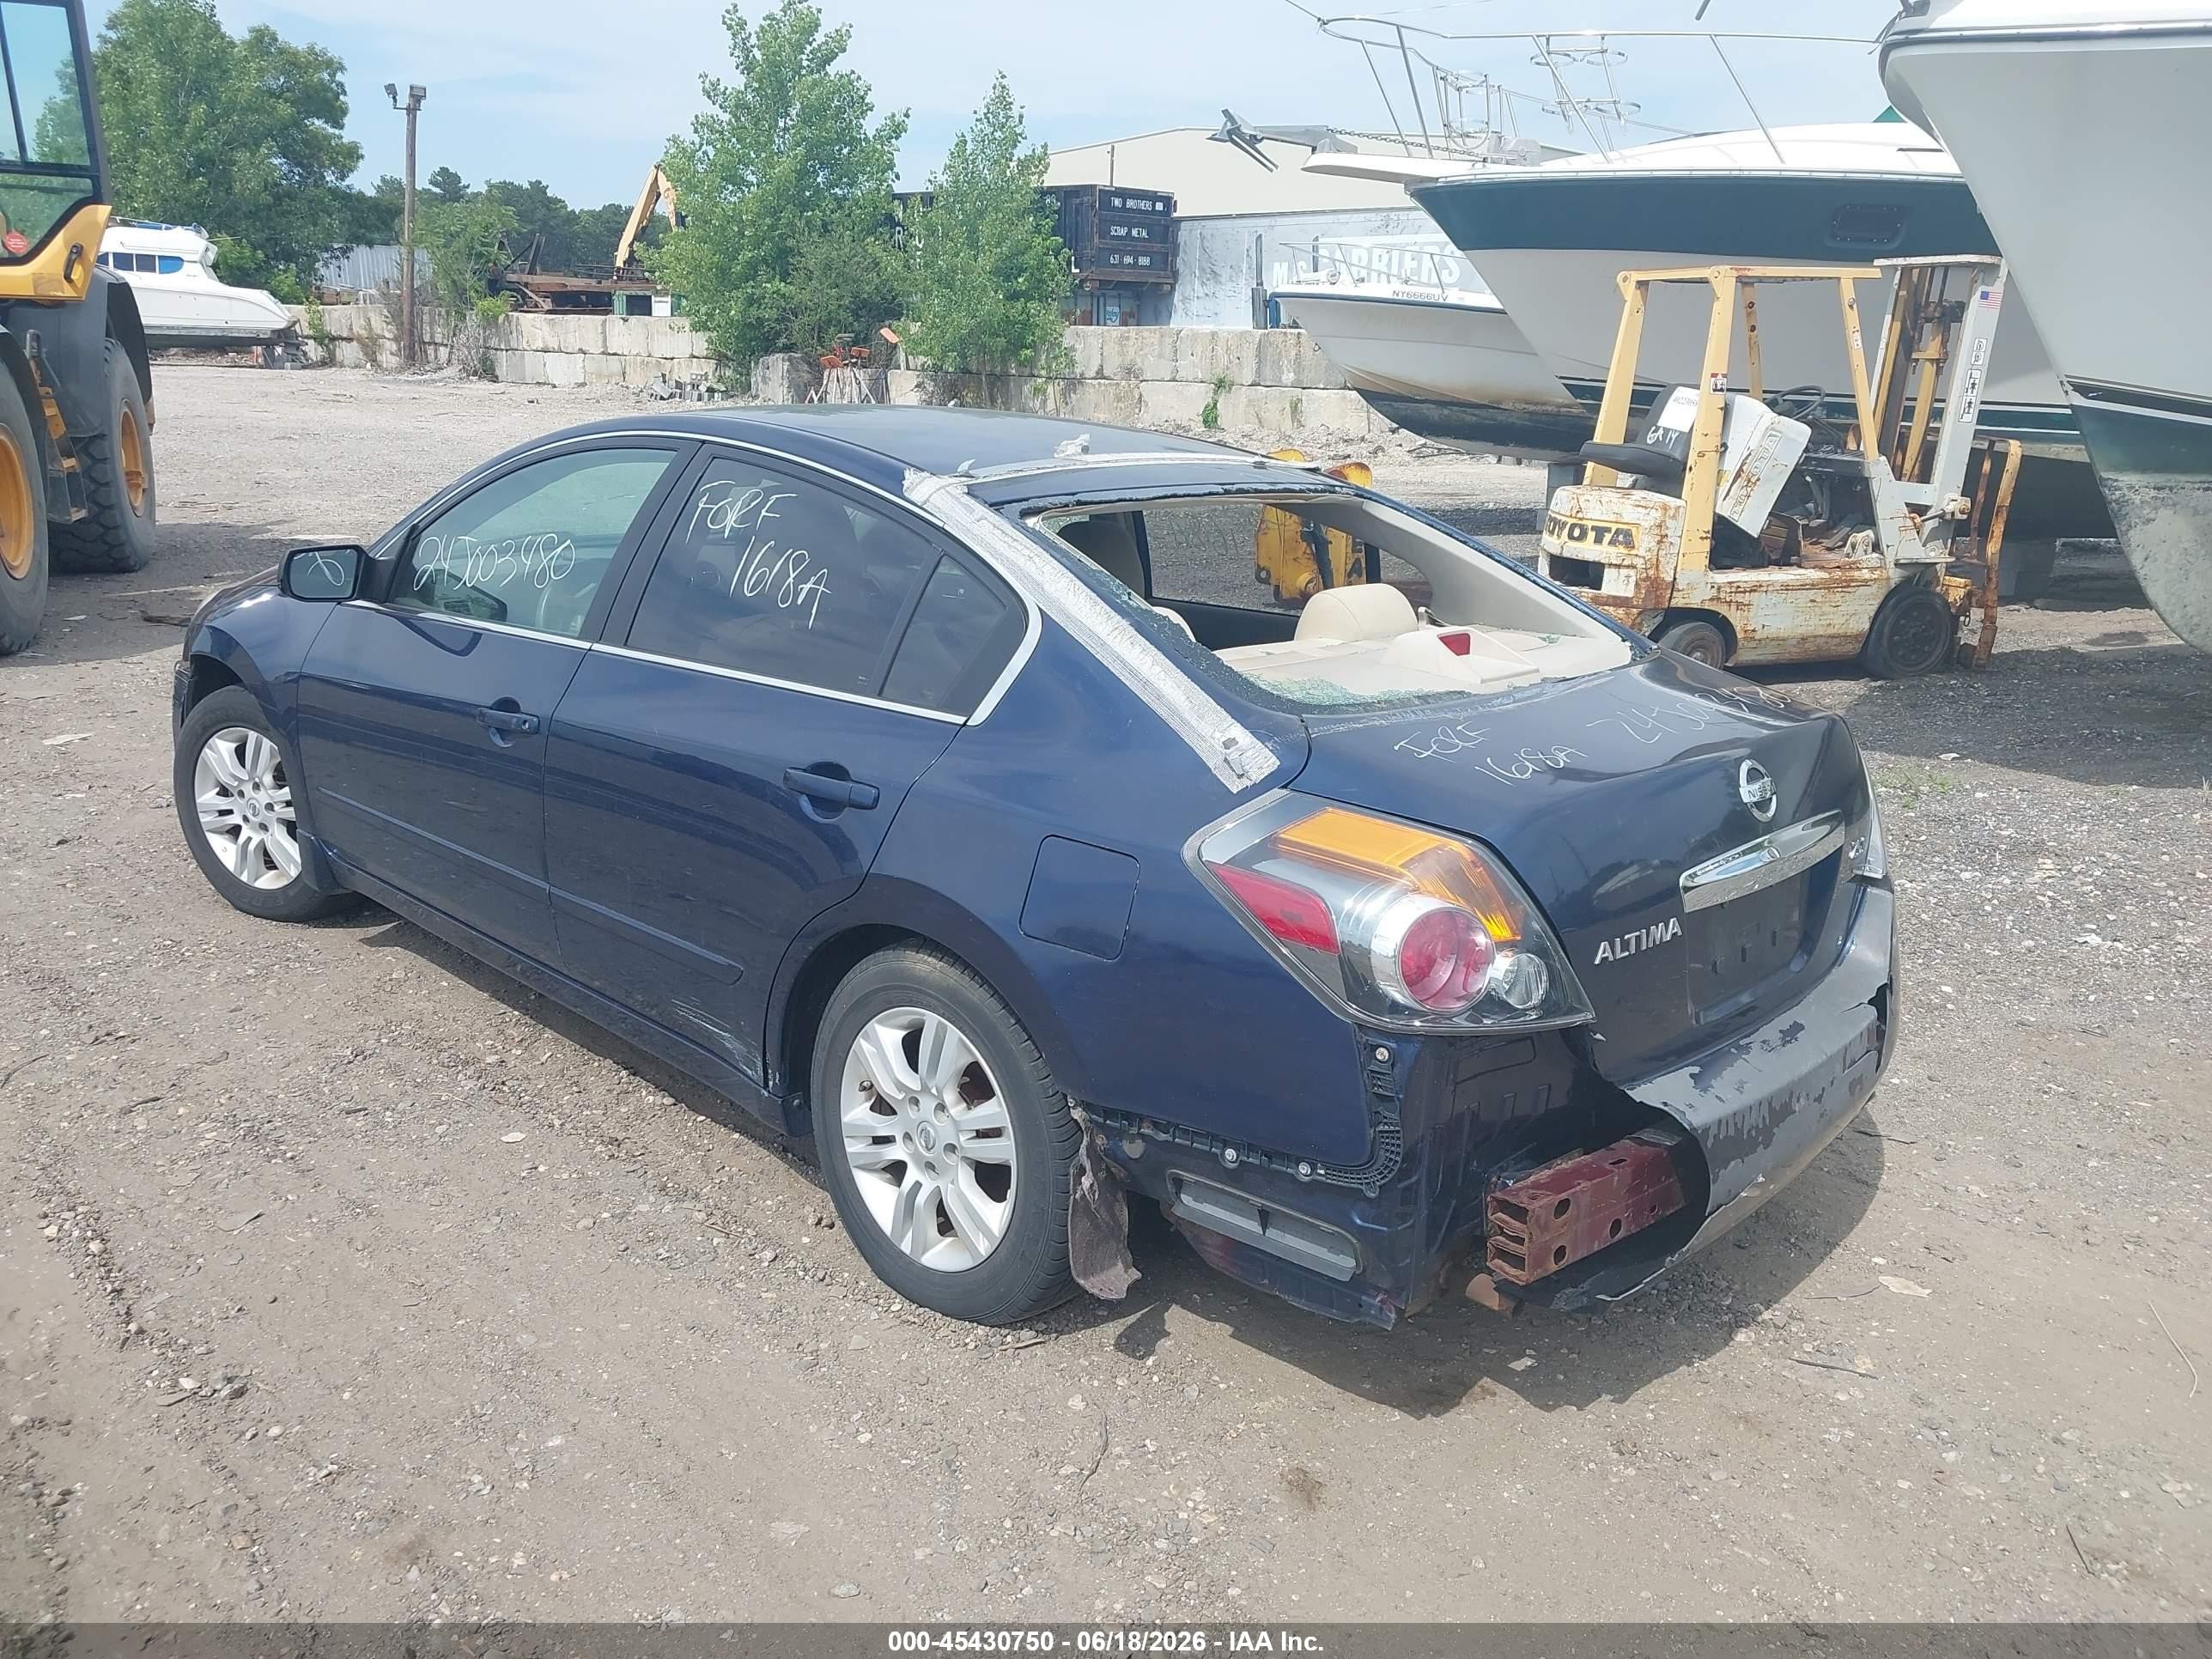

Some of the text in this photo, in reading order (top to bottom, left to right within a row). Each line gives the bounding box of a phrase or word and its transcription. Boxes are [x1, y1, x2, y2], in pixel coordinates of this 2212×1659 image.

[1110, 197, 1152, 211] TWO BROTHERS
[1110, 225, 1149, 239] SCRAP METAL
[729, 535, 832, 629] 1618A
[1594, 916, 1684, 965] ALTIMA
